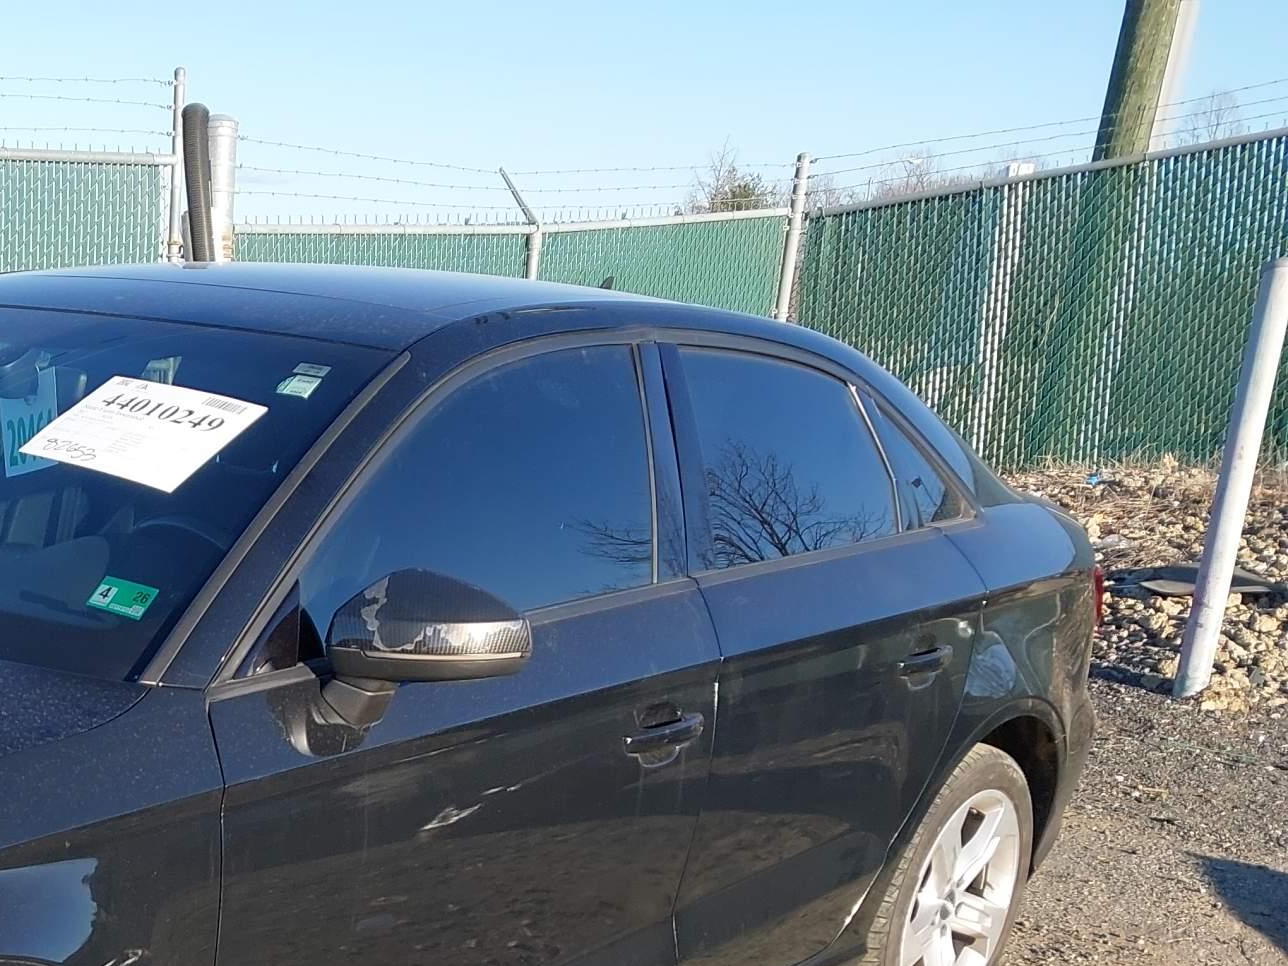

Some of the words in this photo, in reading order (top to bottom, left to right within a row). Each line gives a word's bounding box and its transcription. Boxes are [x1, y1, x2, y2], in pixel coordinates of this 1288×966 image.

[102, 393, 225, 432] 44010249
[98, 586, 112, 600] 4
[133, 591, 151, 604] 26
